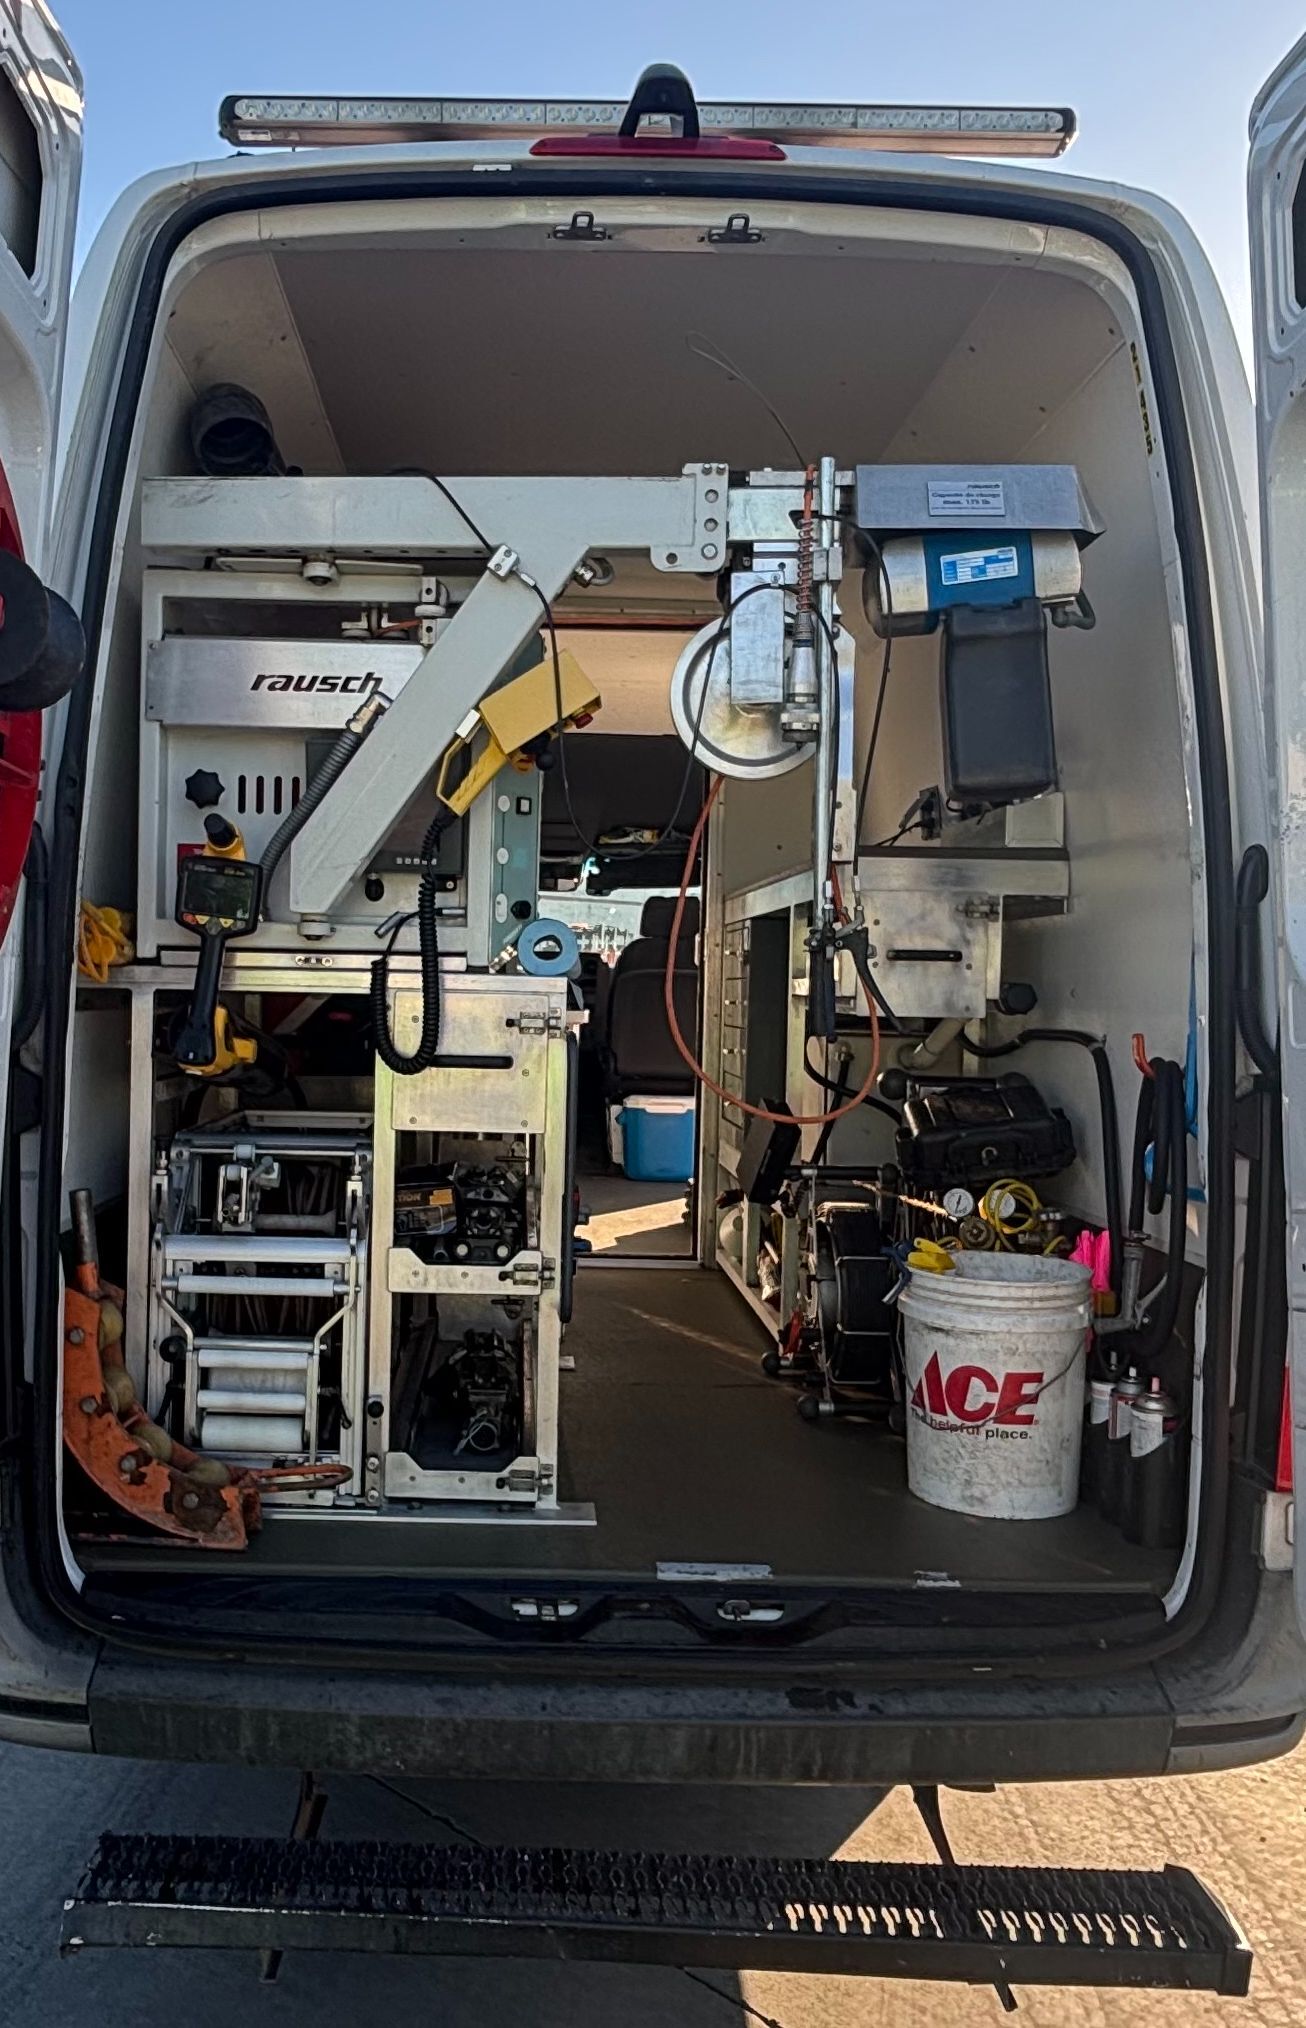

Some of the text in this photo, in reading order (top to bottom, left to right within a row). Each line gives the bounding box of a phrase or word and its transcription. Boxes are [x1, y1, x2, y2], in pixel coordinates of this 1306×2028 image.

[250, 672, 383, 693] rausch
[911, 1350, 1044, 1425] ACE
[985, 1427, 1033, 1441] place.
